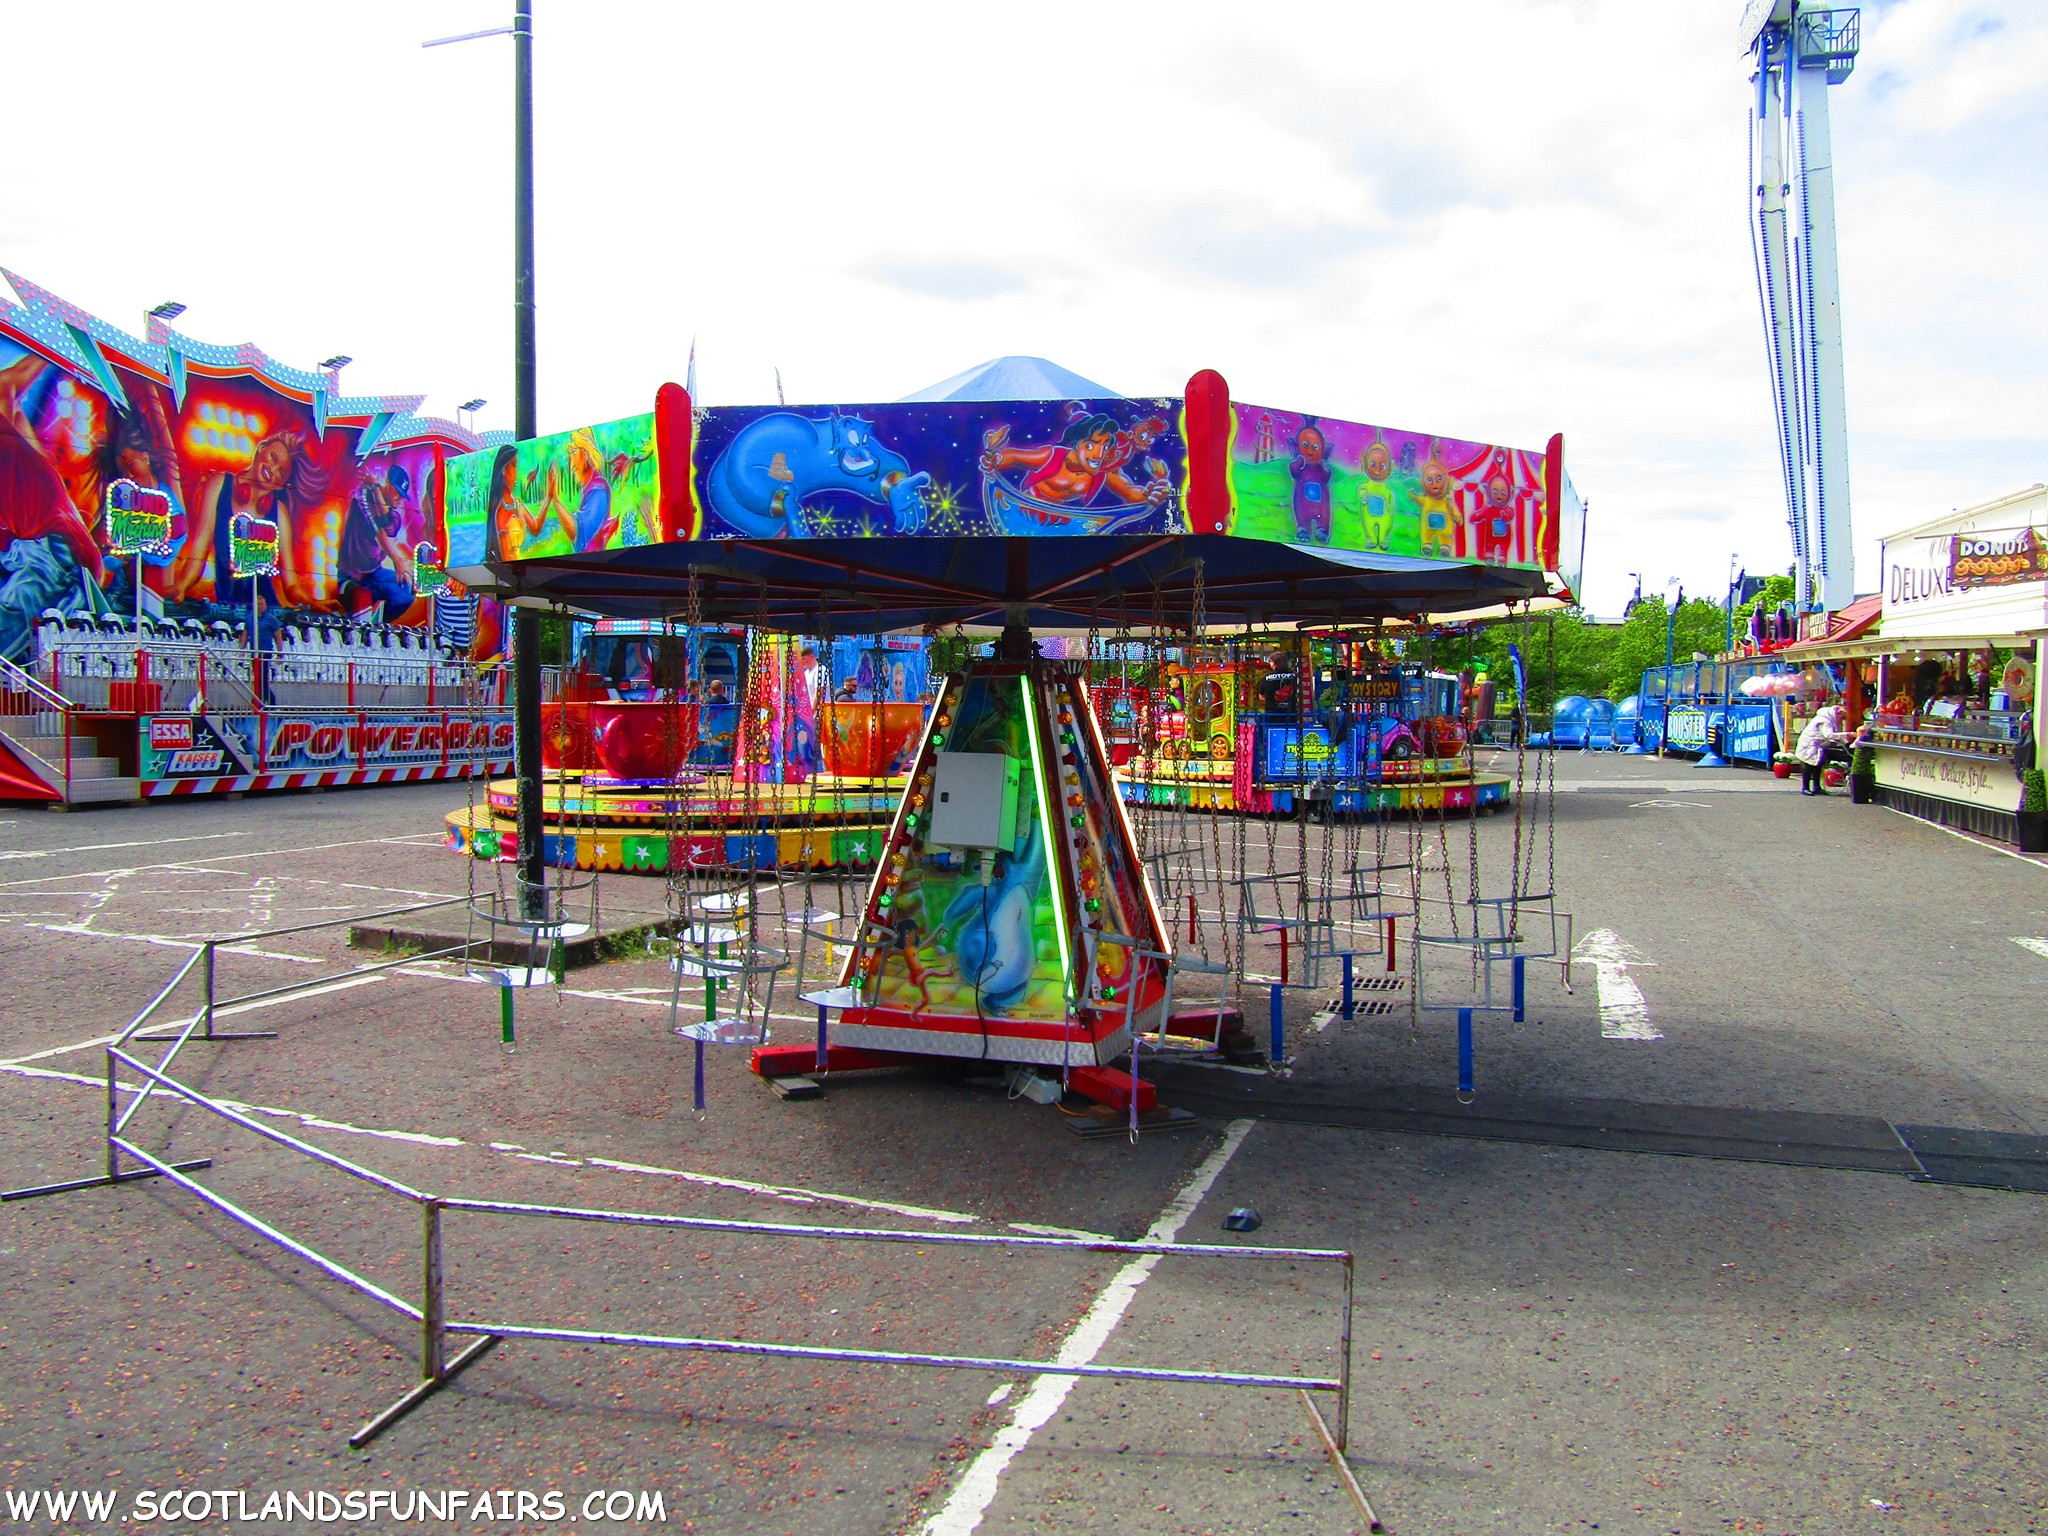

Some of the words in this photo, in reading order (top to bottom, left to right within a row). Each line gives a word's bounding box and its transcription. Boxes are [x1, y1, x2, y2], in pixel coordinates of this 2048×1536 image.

[112, 482, 169, 516] SOUND
[1960, 538, 2028, 557] DONUTS
[1891, 564, 1953, 605] DELUXE
[153, 723, 191, 740] ESSA
[1667, 714, 1706, 740] BOOSTER
[175, 761, 217, 769] RIDES
[177, 753, 219, 763] KAISER
